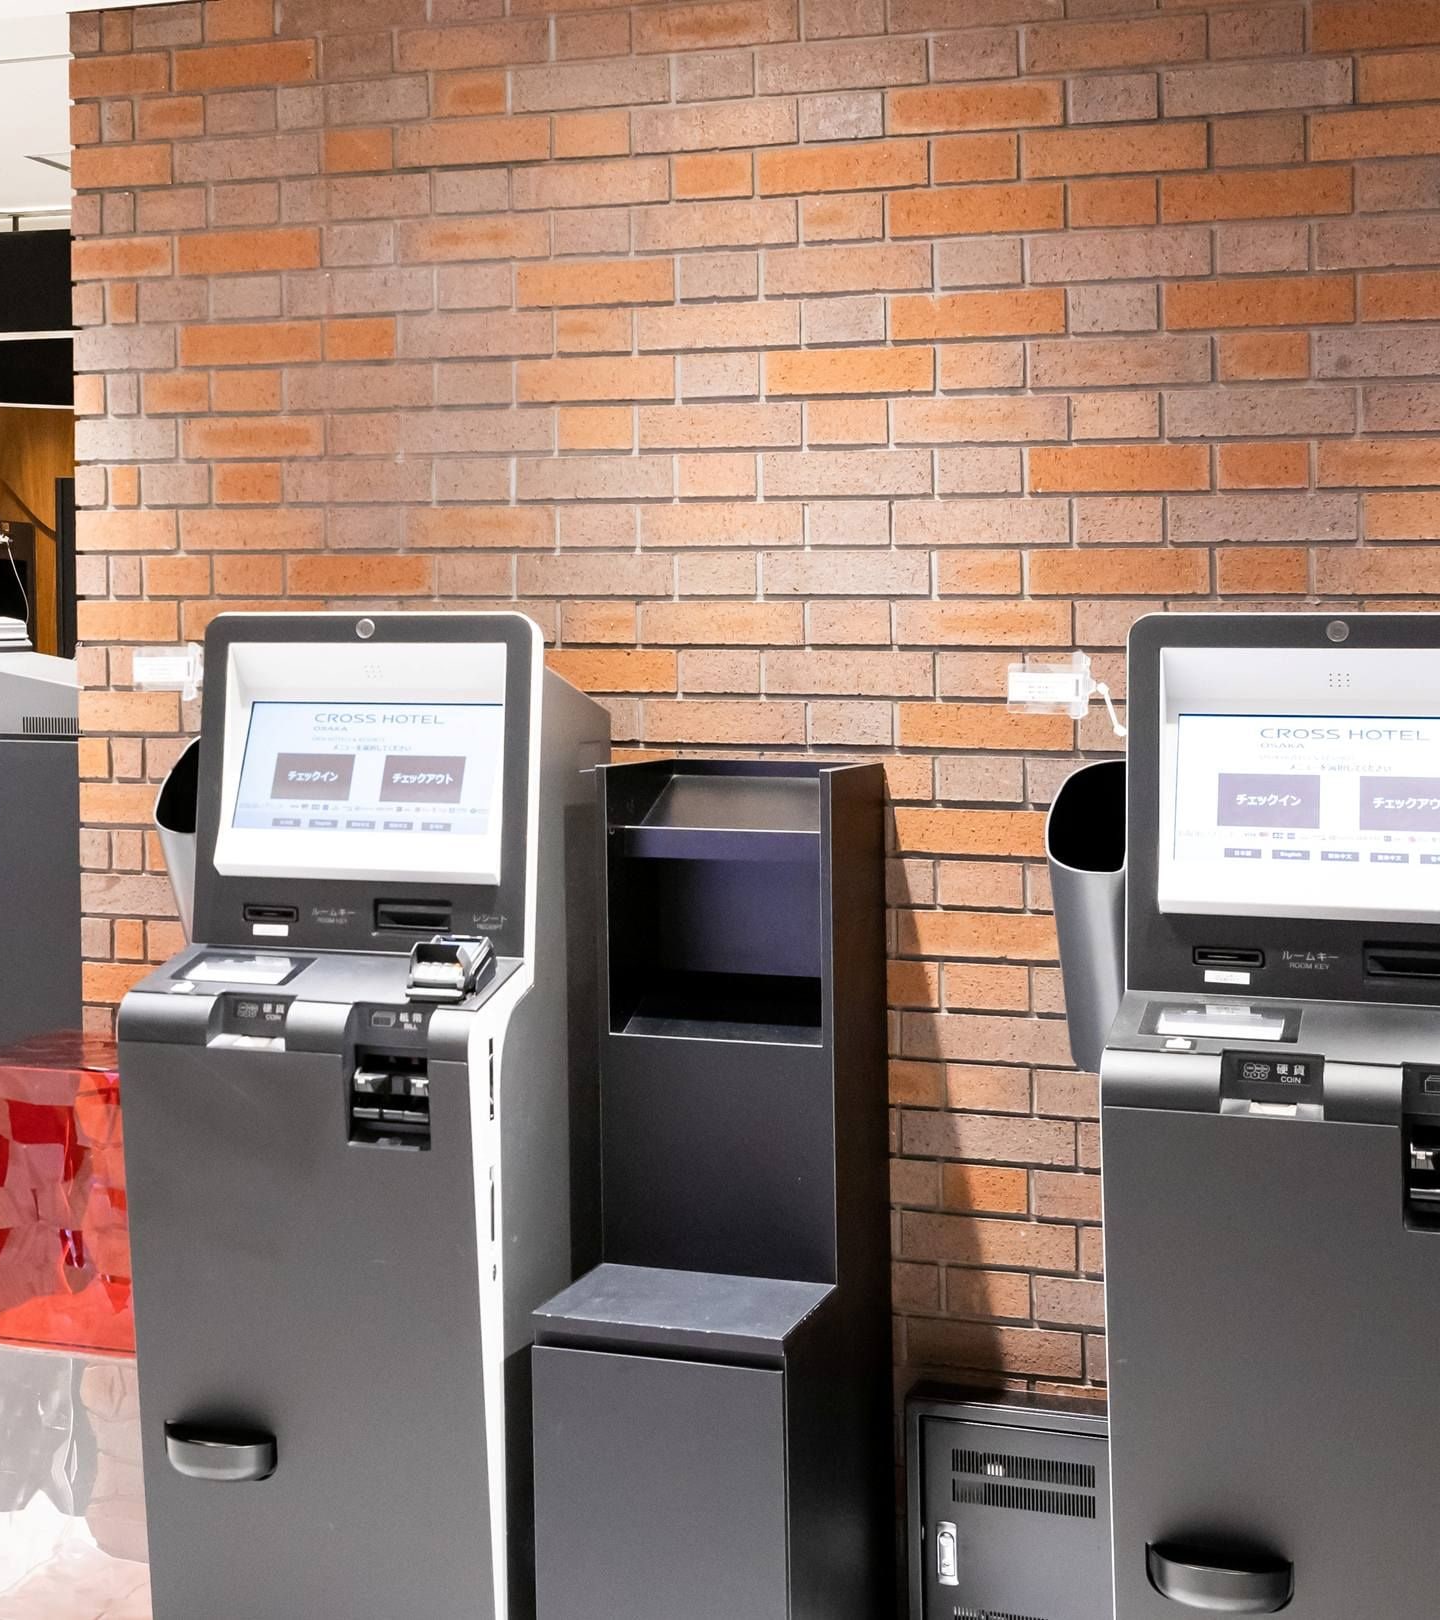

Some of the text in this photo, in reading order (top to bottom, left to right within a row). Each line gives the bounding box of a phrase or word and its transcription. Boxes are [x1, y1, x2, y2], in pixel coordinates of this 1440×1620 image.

[314, 713, 446, 725] CROSS HOTEL
[1260, 728, 1430, 741] CROSS HOTEL
[287, 770, 339, 782] チェックイン
[392, 772, 454, 785] チェックアウト
[1236, 793, 1302, 806] チェックイン
[1282, 950, 1340, 961] ルームキー
[1314, 962, 1330, 970] KEY
[1280, 1076, 1302, 1084] COIN
